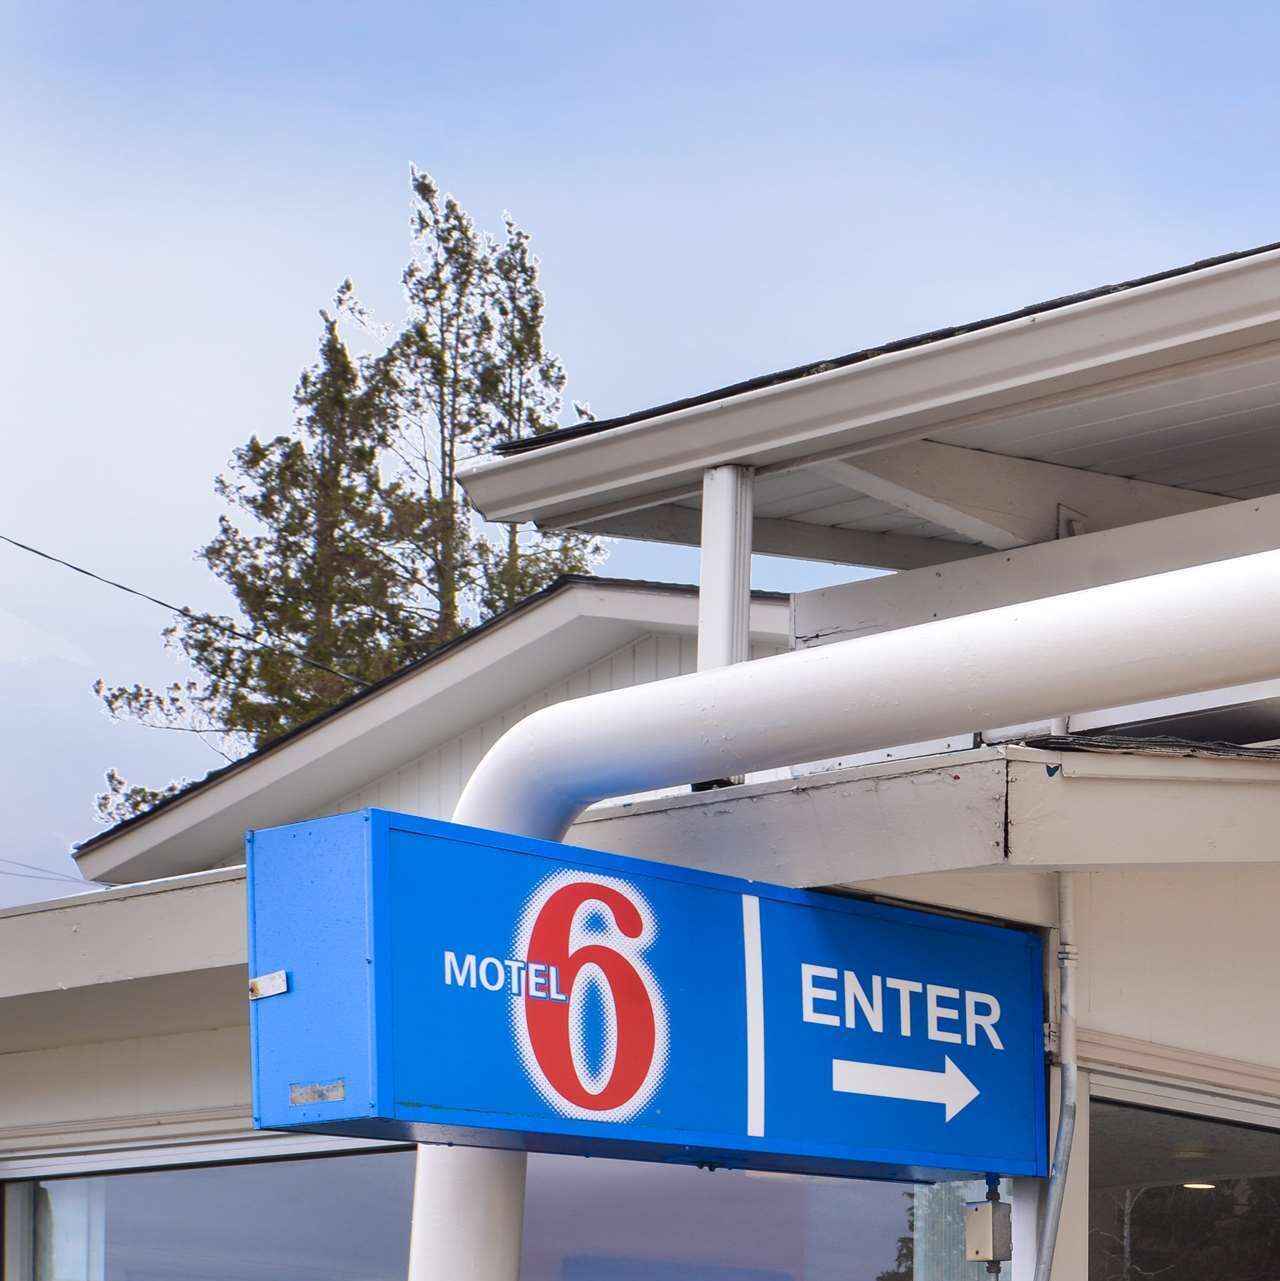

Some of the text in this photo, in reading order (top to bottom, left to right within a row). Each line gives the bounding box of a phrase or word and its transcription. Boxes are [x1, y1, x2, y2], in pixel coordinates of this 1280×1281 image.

[444, 881, 656, 1112] MOTEL 6
[801, 963, 1004, 1051] ENTER
